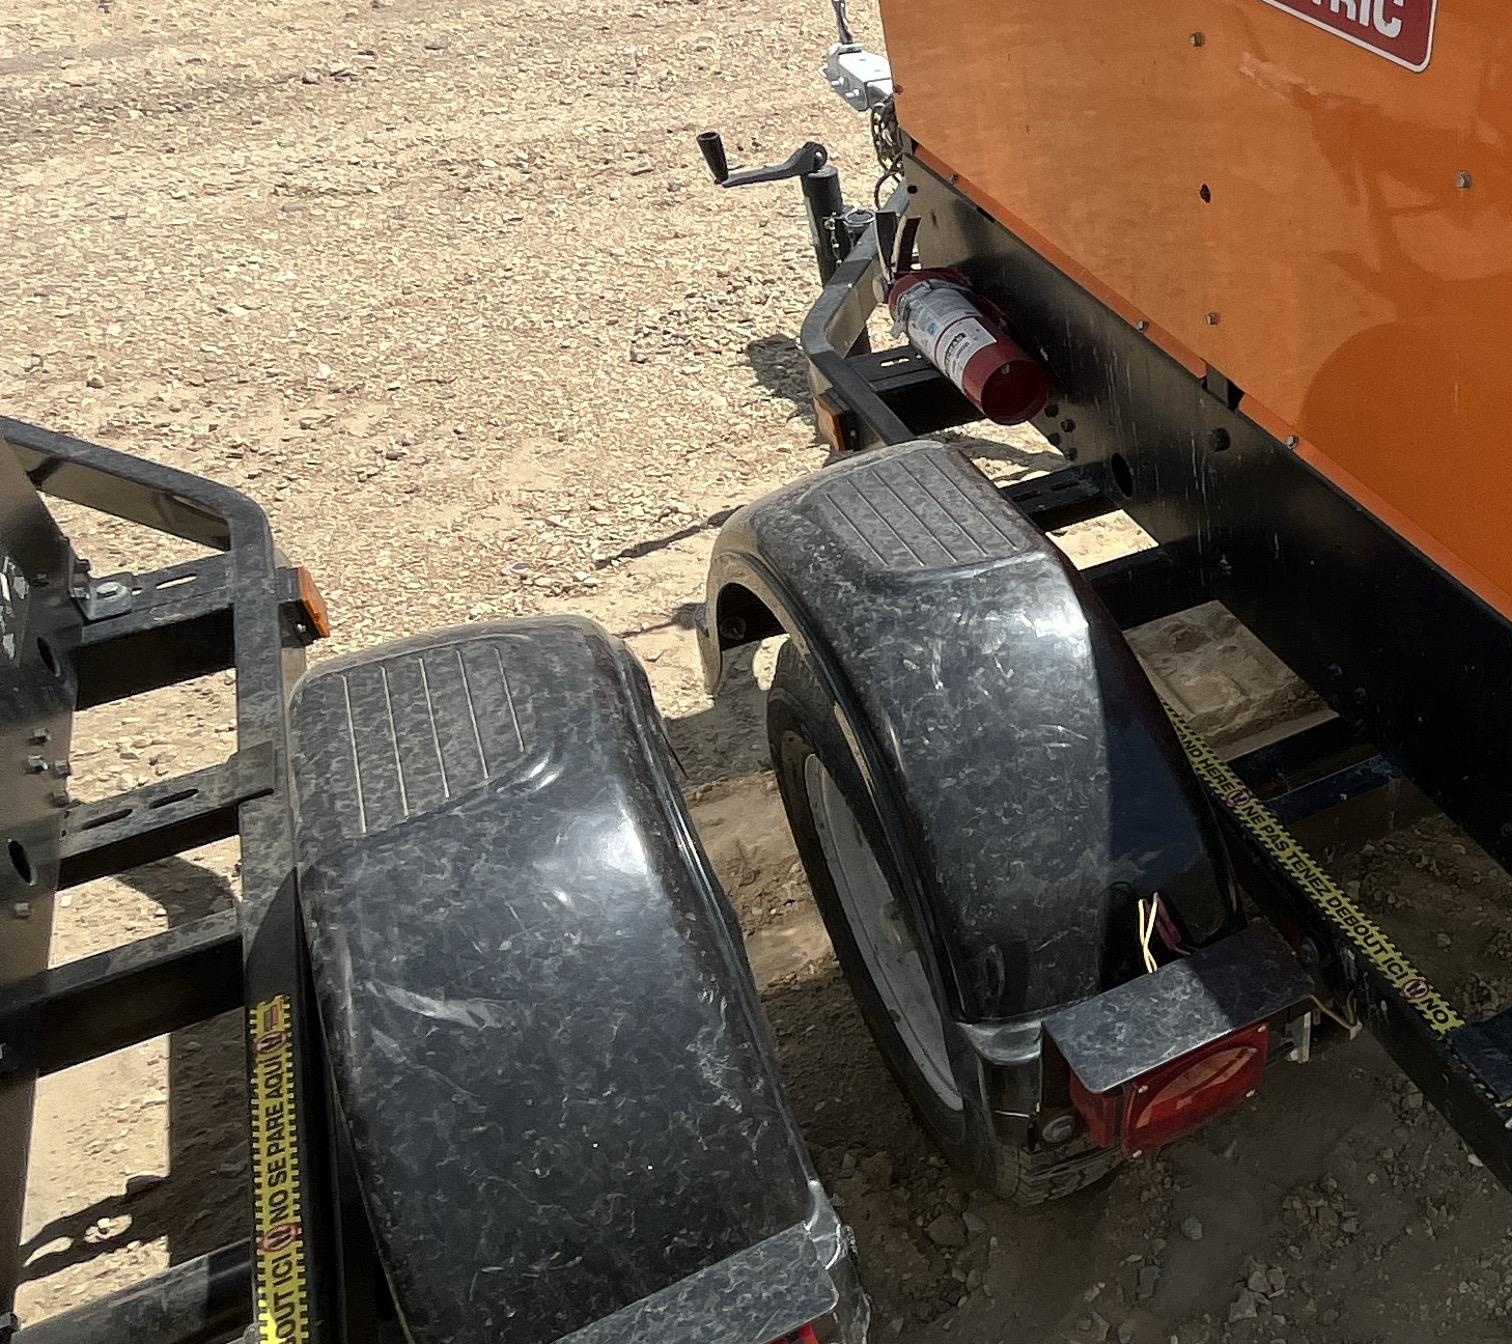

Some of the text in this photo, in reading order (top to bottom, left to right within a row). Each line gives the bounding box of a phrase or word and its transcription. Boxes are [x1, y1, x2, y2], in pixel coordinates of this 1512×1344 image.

[1198, 758, 1236, 792] HERE
[1243, 805, 1409, 980] NE PAS TENEZ DEBOUT ICI
[1422, 998, 1449, 1024] NO
[265, 1101, 286, 1157] PARE
[268, 1157, 287, 1188] SE
[268, 1189, 289, 1225] NO
[271, 1253, 293, 1287] ICI
